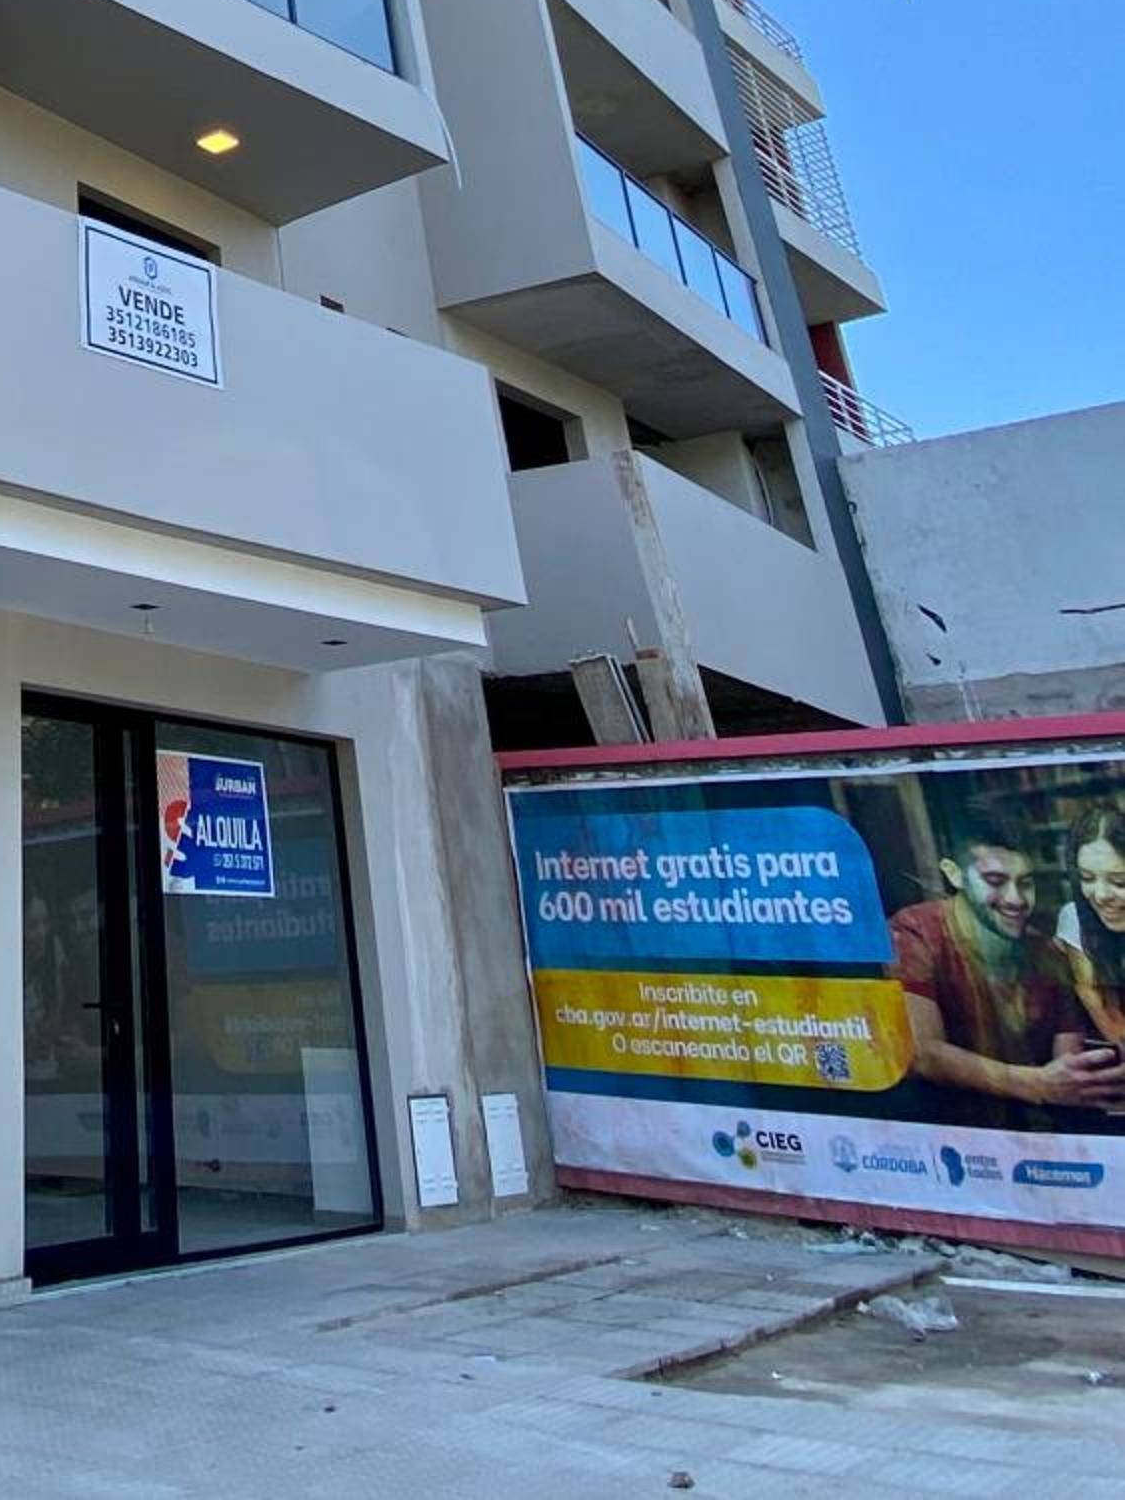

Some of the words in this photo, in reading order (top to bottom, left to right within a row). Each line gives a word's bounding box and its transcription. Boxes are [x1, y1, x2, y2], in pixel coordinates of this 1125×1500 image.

[118, 285, 184, 325] VENDE
[106, 305, 195, 348] 3512186185
[108, 325, 198, 367] 3513922303
[196, 813, 263, 851] ALQUILA
[535, 848, 651, 880] Internet
[657, 844, 752, 888] gratis
[756, 850, 839, 887] para
[539, 891, 593, 922] 600
[600, 888, 647, 922] mil
[653, 887, 853, 925] estudiantes
[639, 982, 727, 1006] Inscribite
[732, 989, 759, 1007] en
[612, 1033, 626, 1053] O
[631, 1037, 750, 1063] escaneando
[754, 1043, 772, 1063] el
[778, 1043, 808, 1066] QR
[756, 1131, 803, 1152] CIEG
